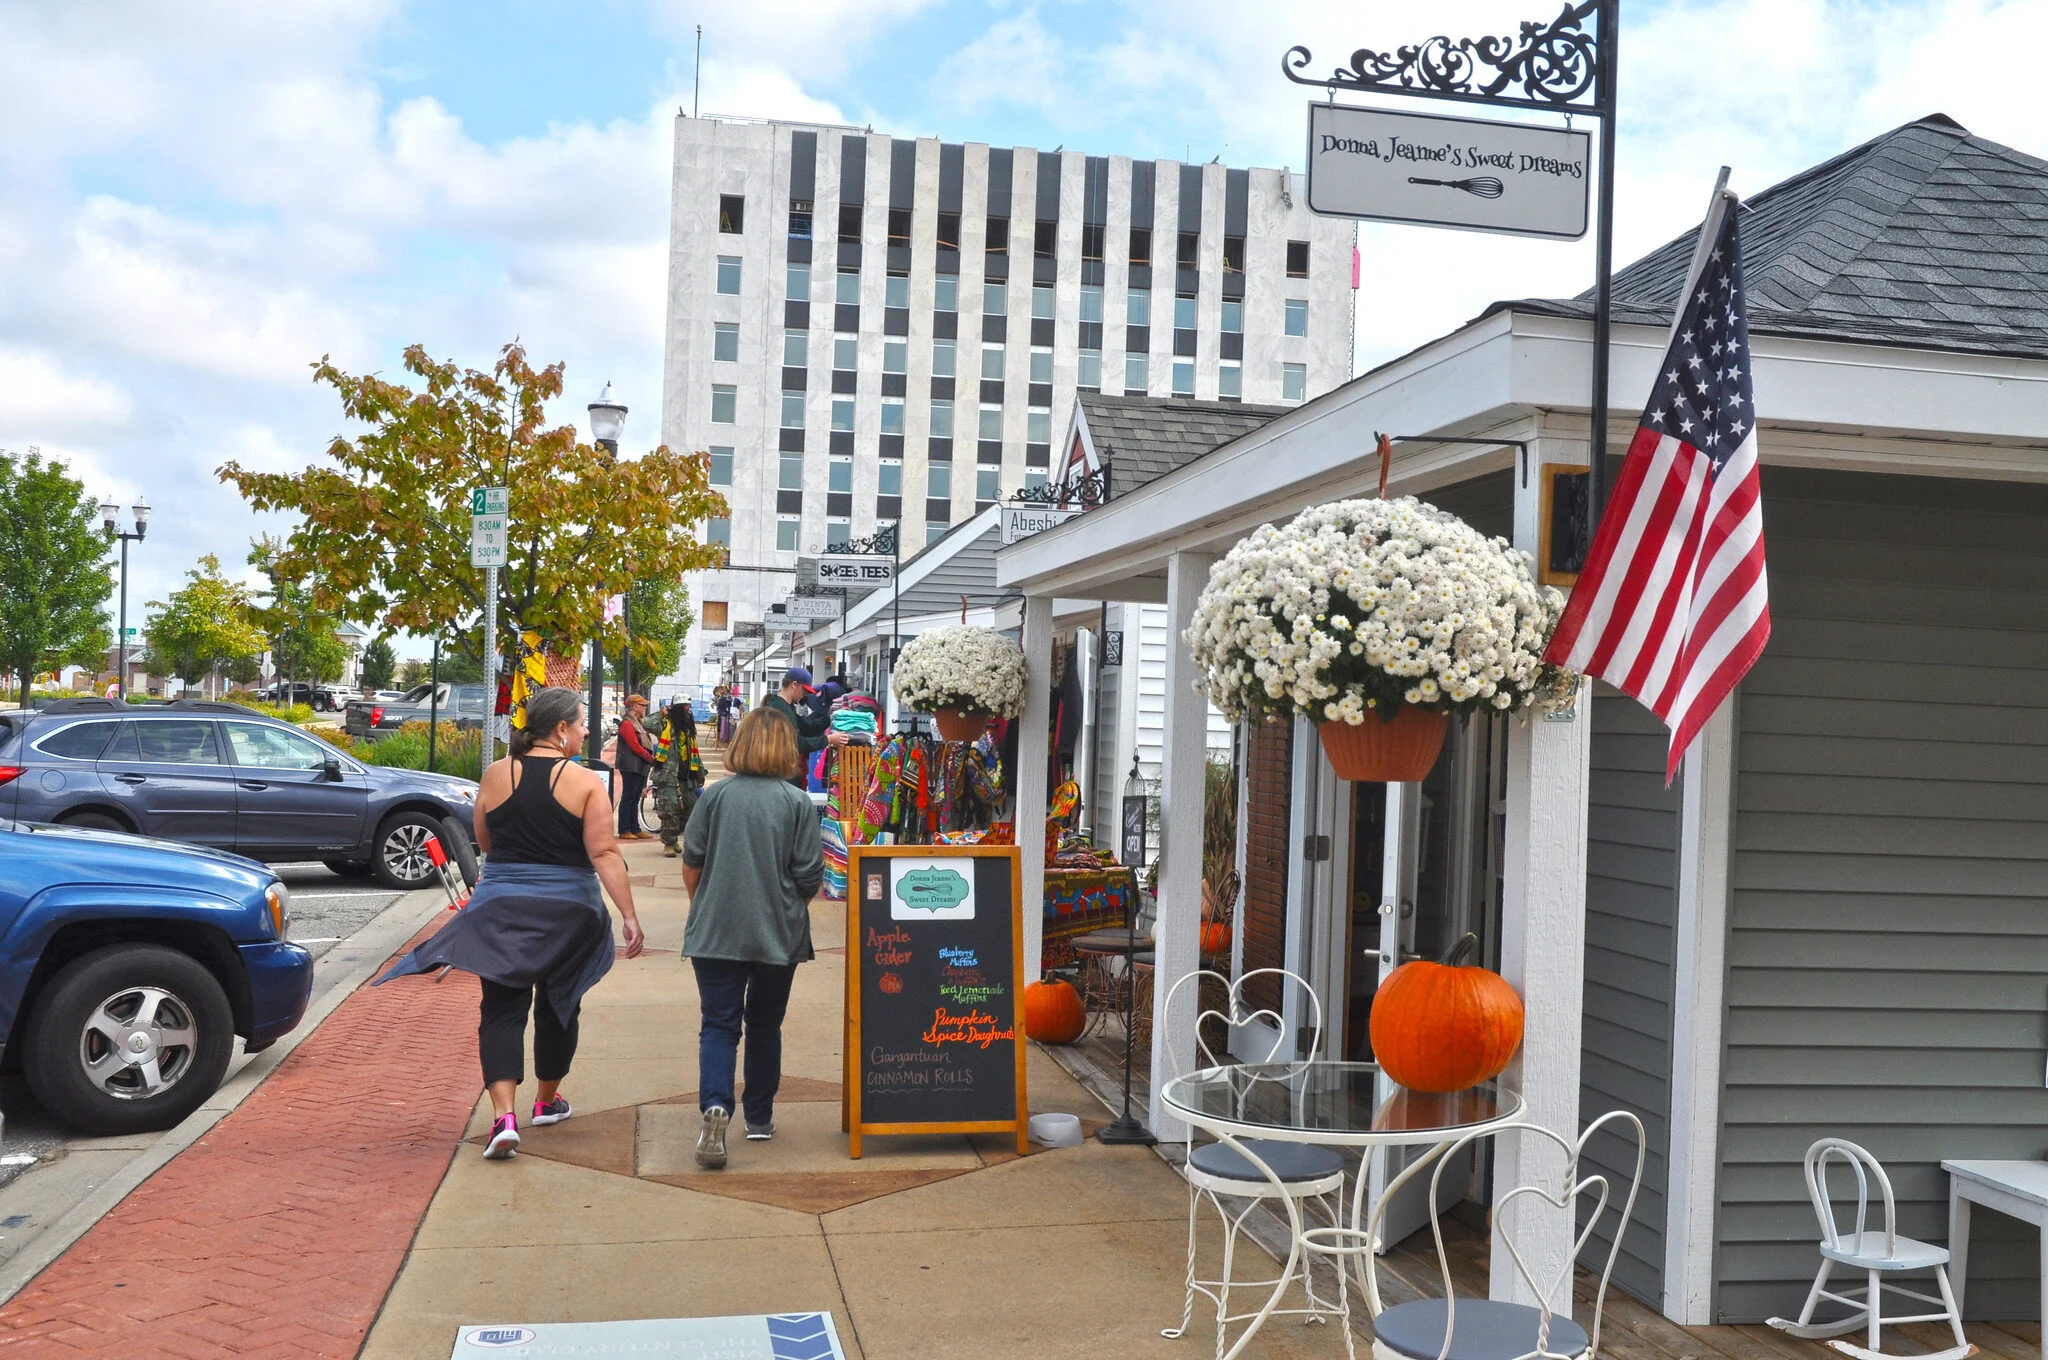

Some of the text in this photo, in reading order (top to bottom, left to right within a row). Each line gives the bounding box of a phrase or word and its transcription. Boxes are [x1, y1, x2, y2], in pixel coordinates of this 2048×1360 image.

[1320, 134, 1582, 179] Donna Jeanne's Sweet Dreams
[476, 493, 484, 512] 2
[487, 502, 505, 512] PARKING
[486, 534, 493, 543] TO
[860, 566, 890, 578] TEES
[1126, 836, 1140, 852] OPEN
[867, 925, 911, 950] Apple
[939, 946, 974, 959] Blueberry
[960, 982, 1004, 995] Lemonade
[952, 994, 987, 1004] Muffins
[935, 1007, 998, 1030] Pumpkin
[922, 1026, 967, 1048] Spice
[871, 1046, 951, 1068] Gargantuan
[868, 1068, 972, 1085] CINNAMON ROLLS
